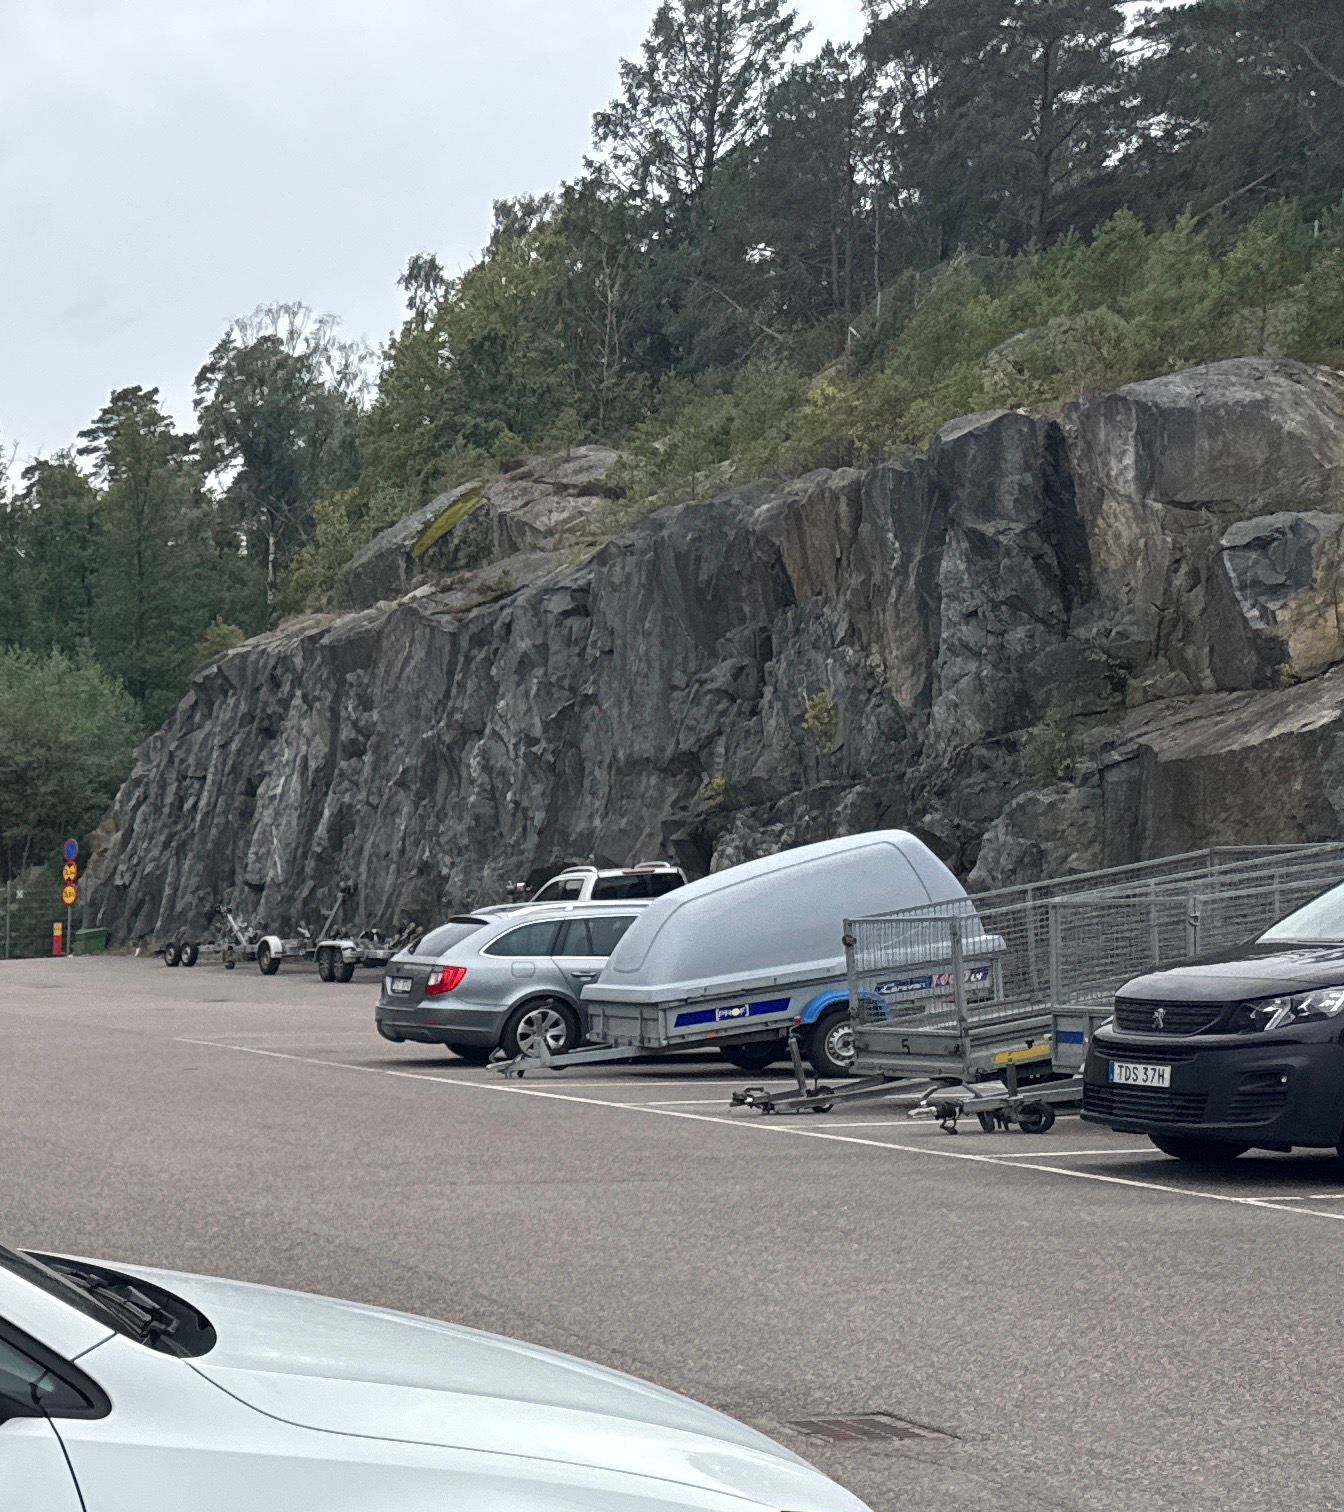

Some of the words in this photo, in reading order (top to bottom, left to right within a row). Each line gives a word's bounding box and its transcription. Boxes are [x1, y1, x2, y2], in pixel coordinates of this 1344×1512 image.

[901, 1038, 911, 1055] 5
[1118, 1065, 1139, 1082] TDS
[1141, 1066, 1165, 1085] 37H
